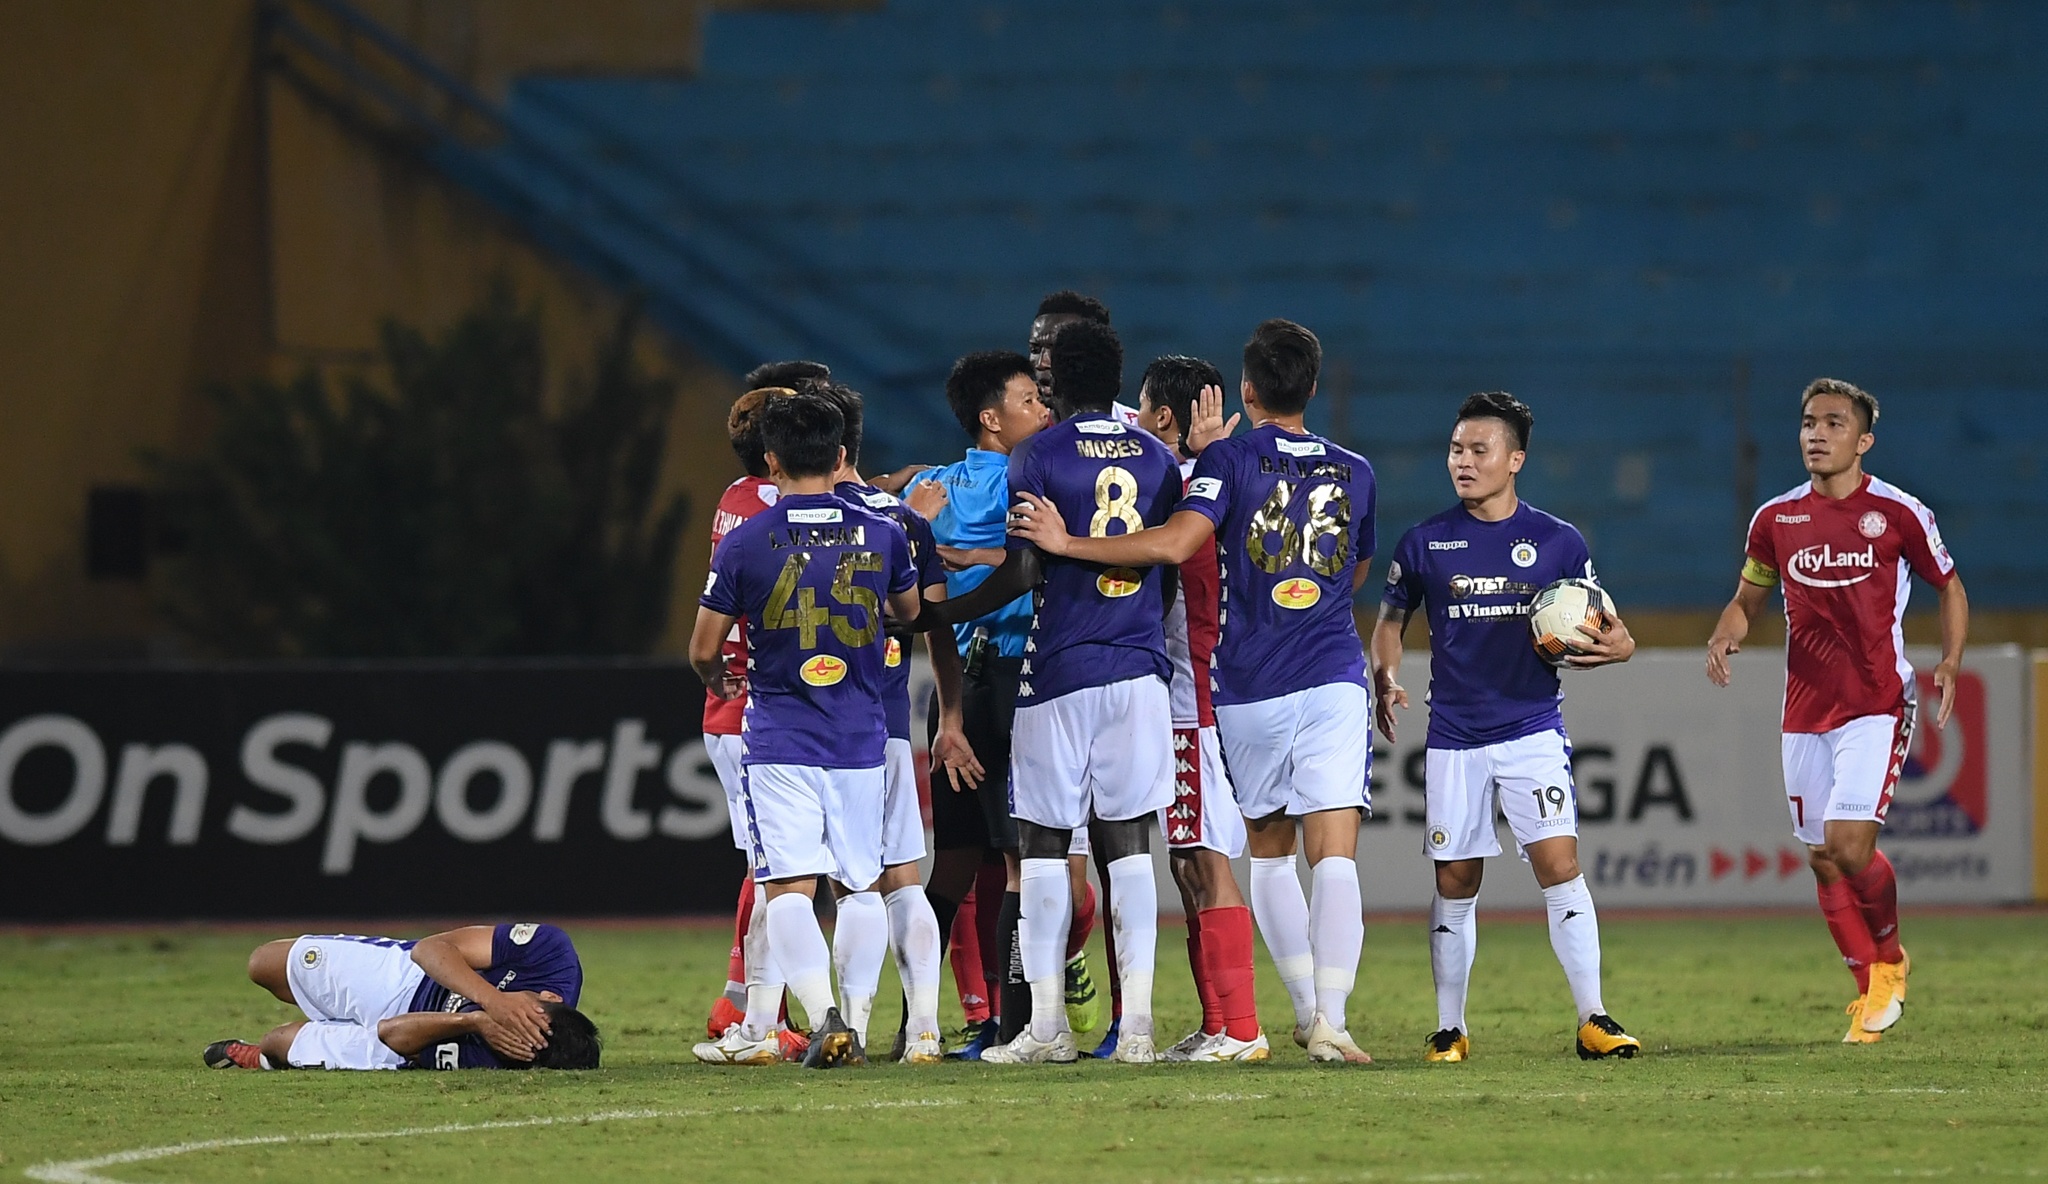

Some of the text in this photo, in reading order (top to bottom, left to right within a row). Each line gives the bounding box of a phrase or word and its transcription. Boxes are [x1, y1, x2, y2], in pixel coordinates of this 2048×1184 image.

[1075, 439, 1143, 459] MOSES
[1089, 465, 1145, 538] 8
[1246, 479, 1351, 577] 68
[1775, 514, 1811, 524] Kappa
[1428, 540, 1469, 551] Kappa
[1473, 576, 1508, 591] T&T
[762, 551, 884, 650] 45
[0, 712, 732, 875] On Sports
[1532, 785, 1566, 819] 19
[1836, 802, 1871, 813] Kappa
[1534, 817, 1571, 830] Kappa
